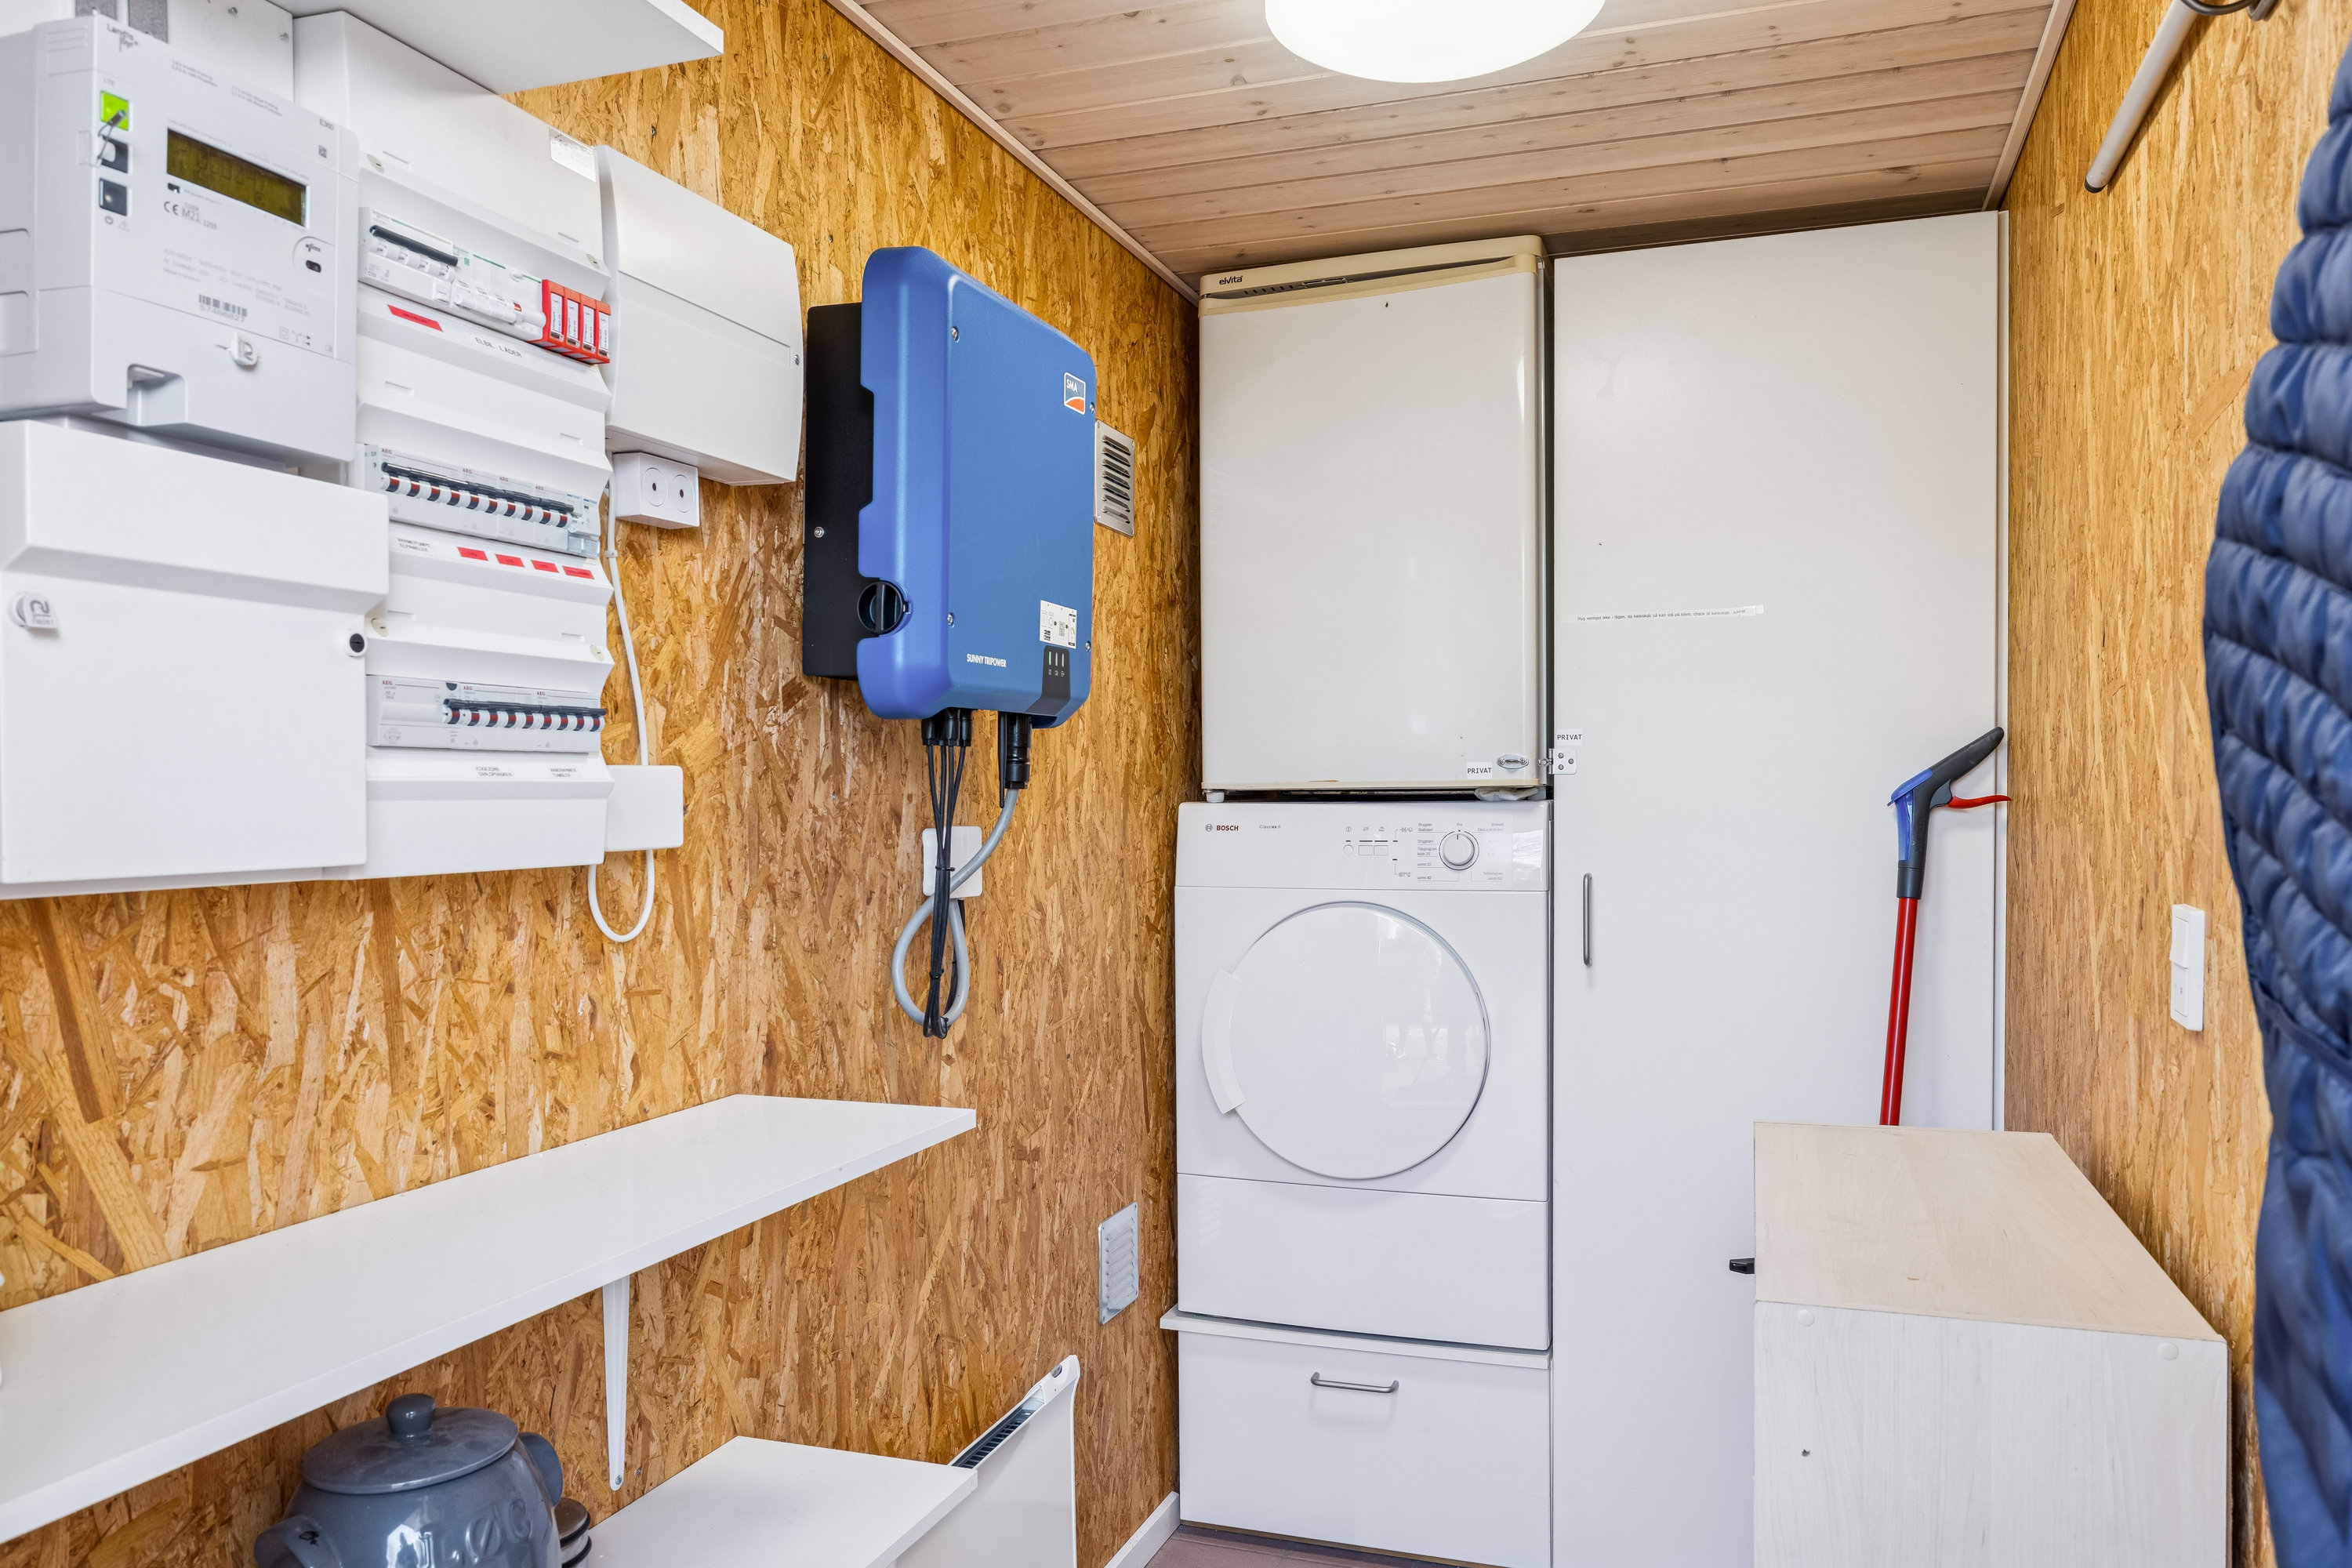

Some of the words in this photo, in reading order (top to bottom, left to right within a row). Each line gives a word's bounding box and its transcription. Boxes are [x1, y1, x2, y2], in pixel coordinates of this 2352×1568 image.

[1066, 379, 1078, 393] SMA
[967, 653, 984, 665] SUNNY
[984, 655, 1007, 668] TRIPOWER
